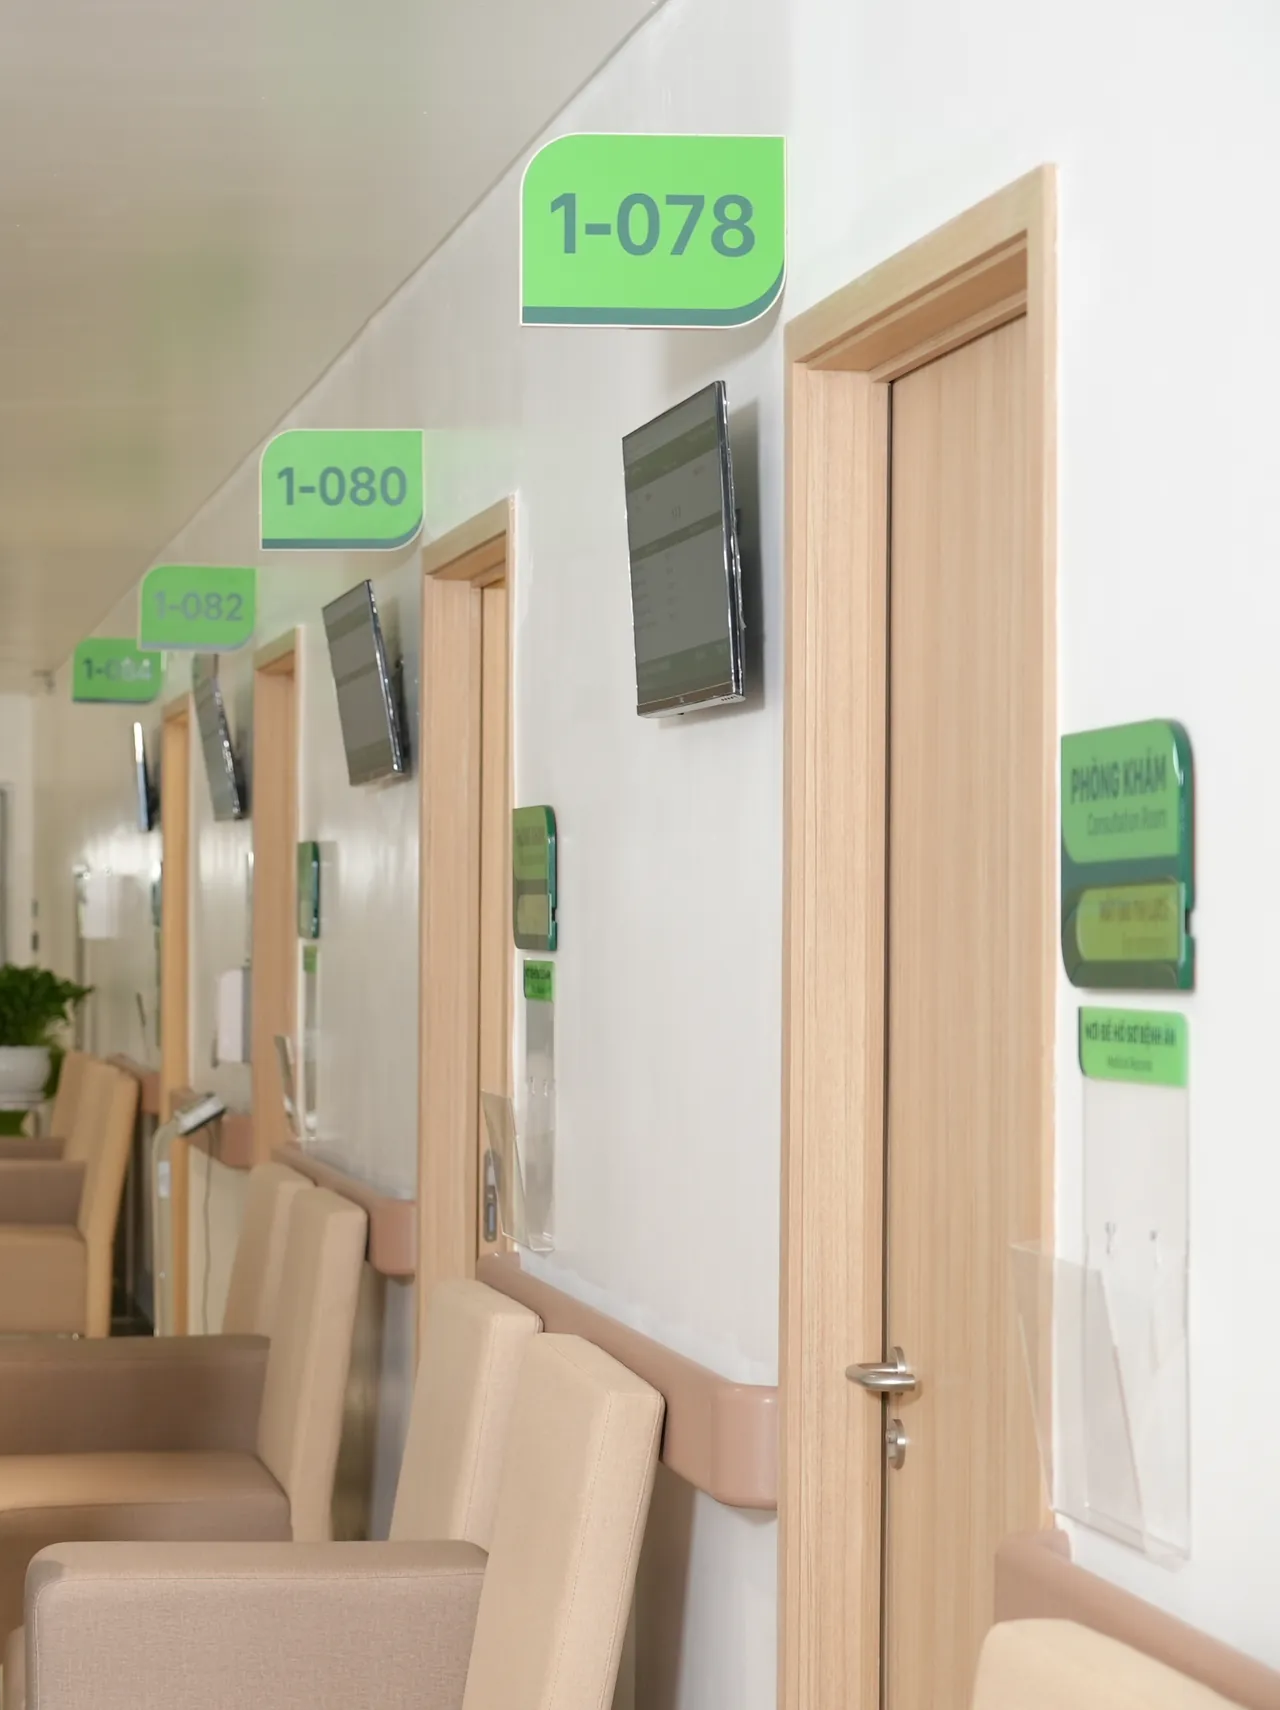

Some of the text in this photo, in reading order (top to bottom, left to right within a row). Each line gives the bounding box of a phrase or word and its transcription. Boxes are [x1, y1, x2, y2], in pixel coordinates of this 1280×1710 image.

[550, 192, 756, 258] 1-078
[277, 465, 408, 507] 1-080
[154, 590, 245, 622] 1-082
[1070, 747, 1167, 805] PHÒNG KHÁM
